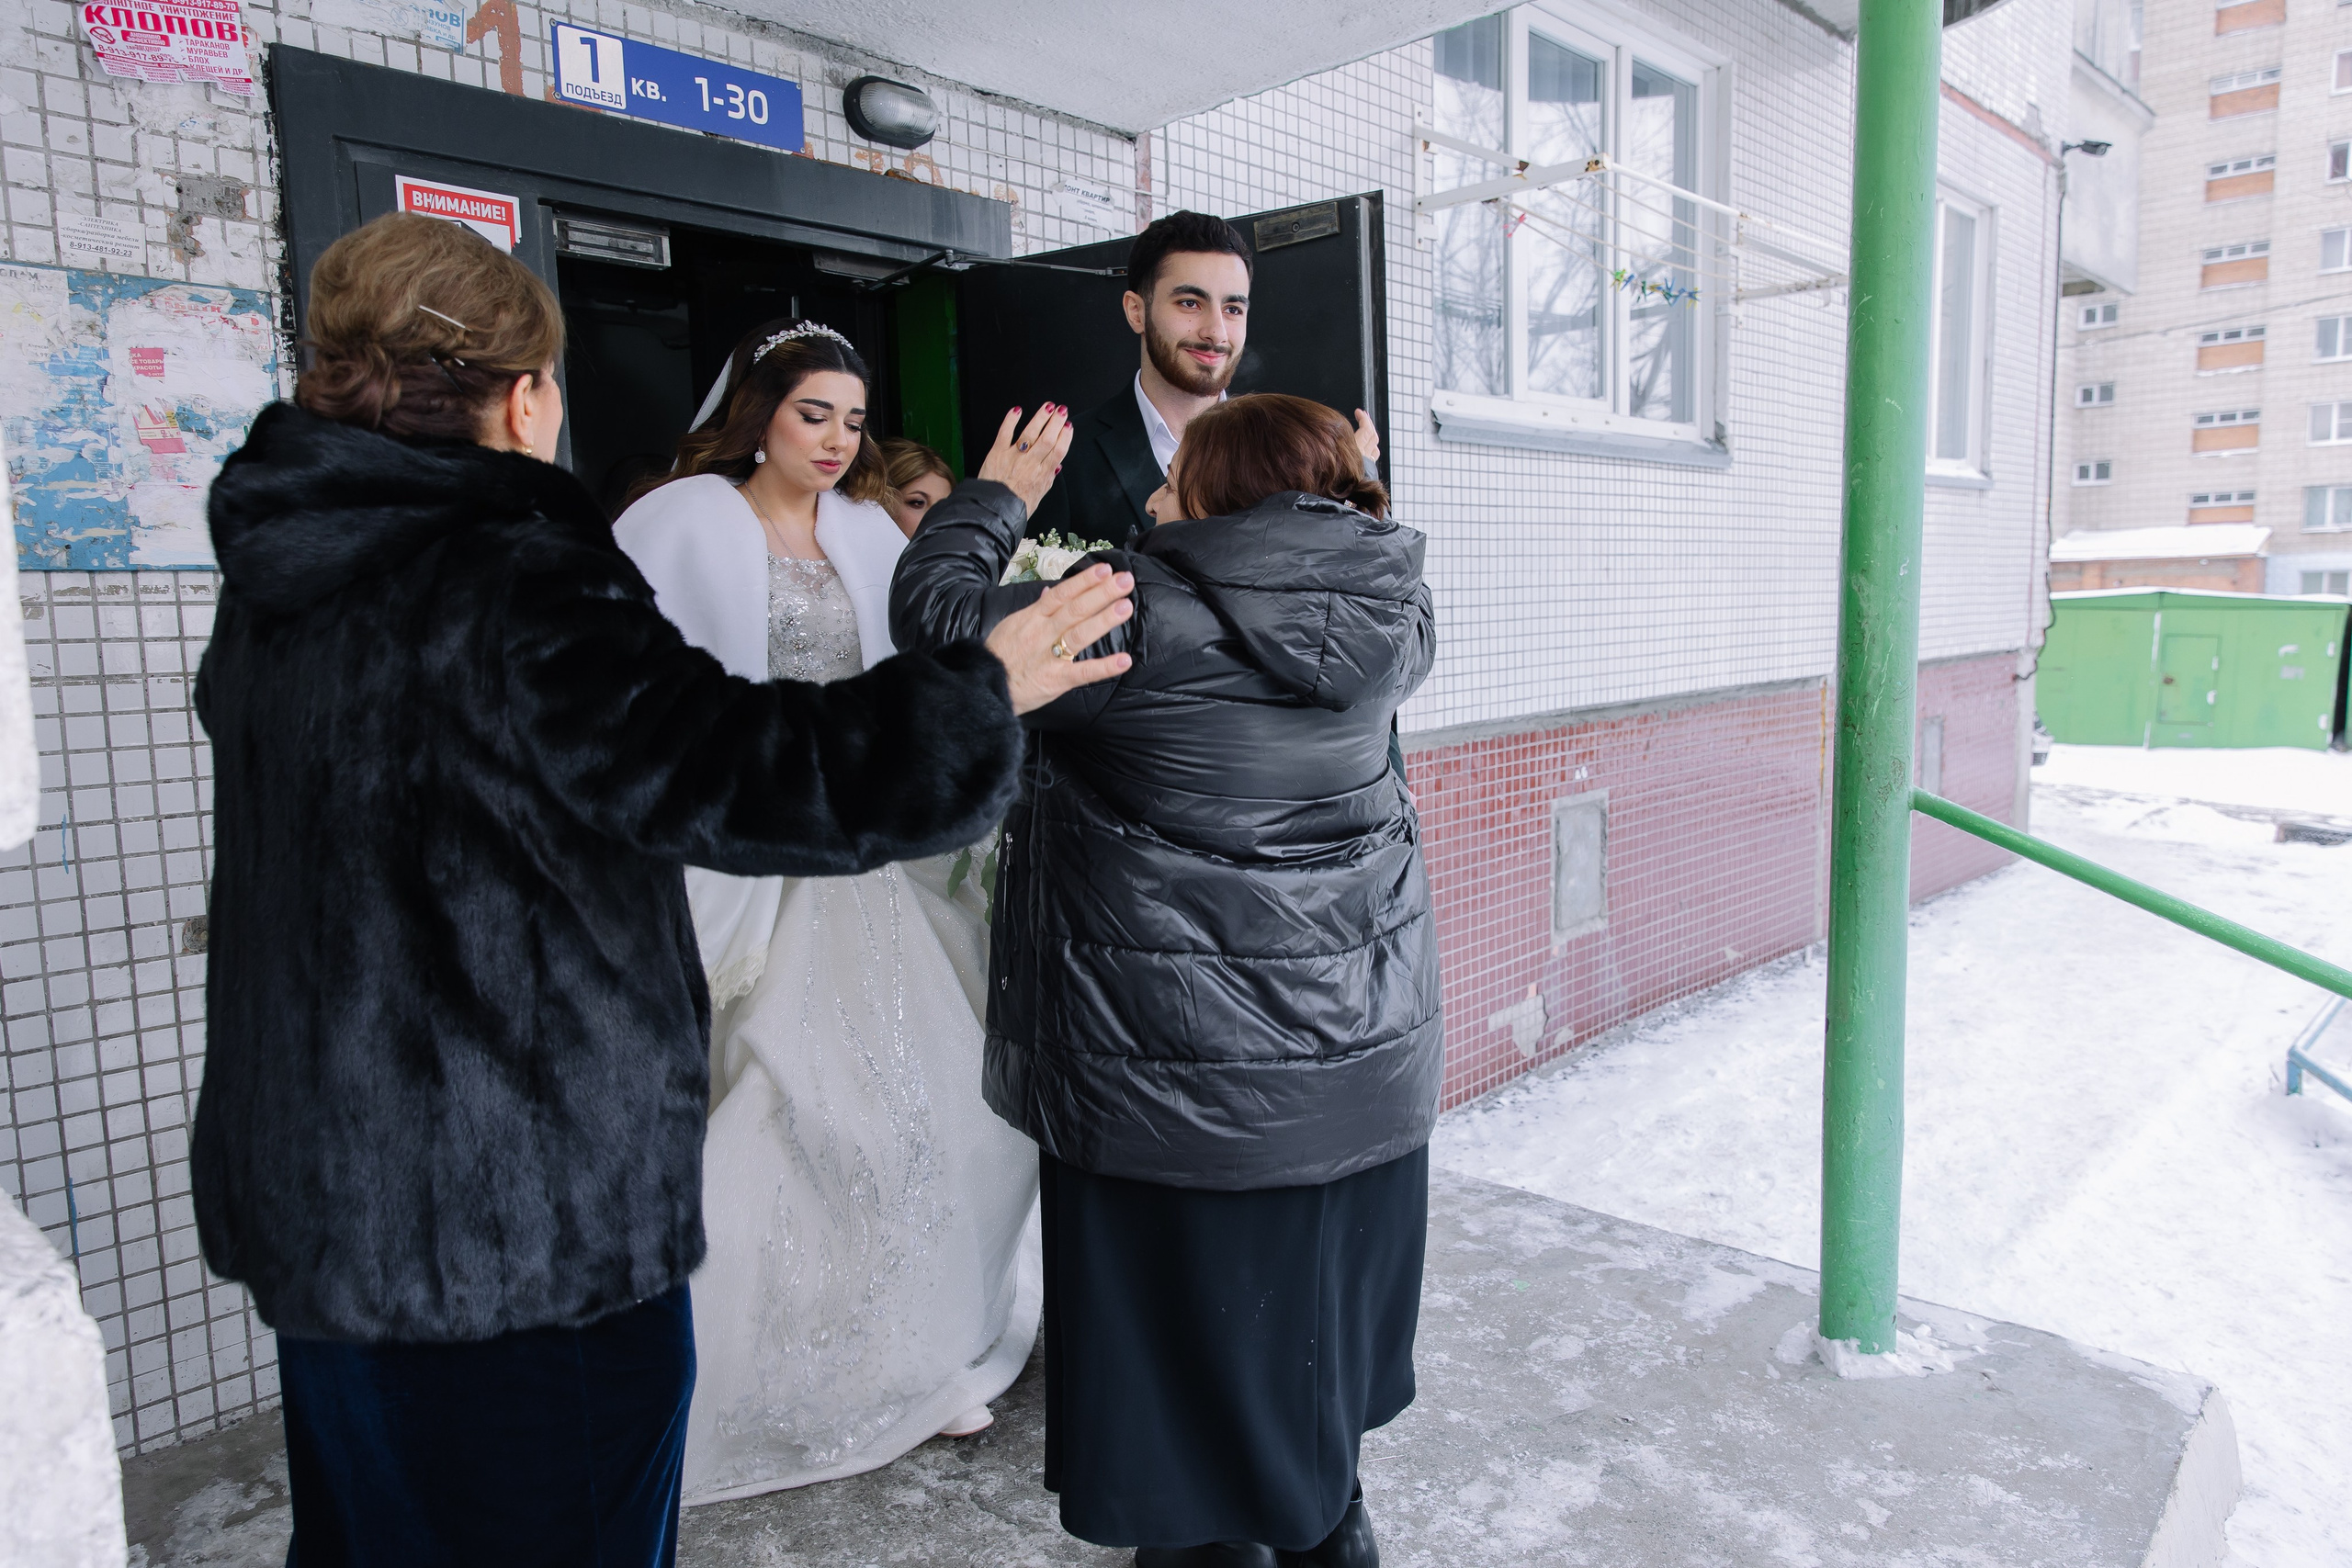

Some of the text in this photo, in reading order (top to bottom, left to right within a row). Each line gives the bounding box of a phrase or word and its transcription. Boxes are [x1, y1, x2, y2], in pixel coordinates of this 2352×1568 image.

[159, 5, 235, 21] УНИЧТОЖЕНИЕ
[85, 6, 239, 42] КЛОПОВ
[185, 39, 230, 51] ТАРАКАНОВ
[187, 47, 228, 58] МУРАВЬЕВ
[188, 55, 209, 64] БЛОХ
[580, 37, 600, 84] 1
[566, 83, 623, 107] ПОДЪЕЗД
[631, 77, 769, 125] КВ. 1-30
[1065, 185, 1080, 194] ОНТ
[1081, 189, 1111, 203] КВАРТИР
[412, 190, 506, 221] ВНИМАНИЕ!
[61, 226, 115, 239] -сборка/разборка
[61, 234, 140, 250] -косметический ремонт
[69, 241, 132, 256] 8-913-481-92-23
